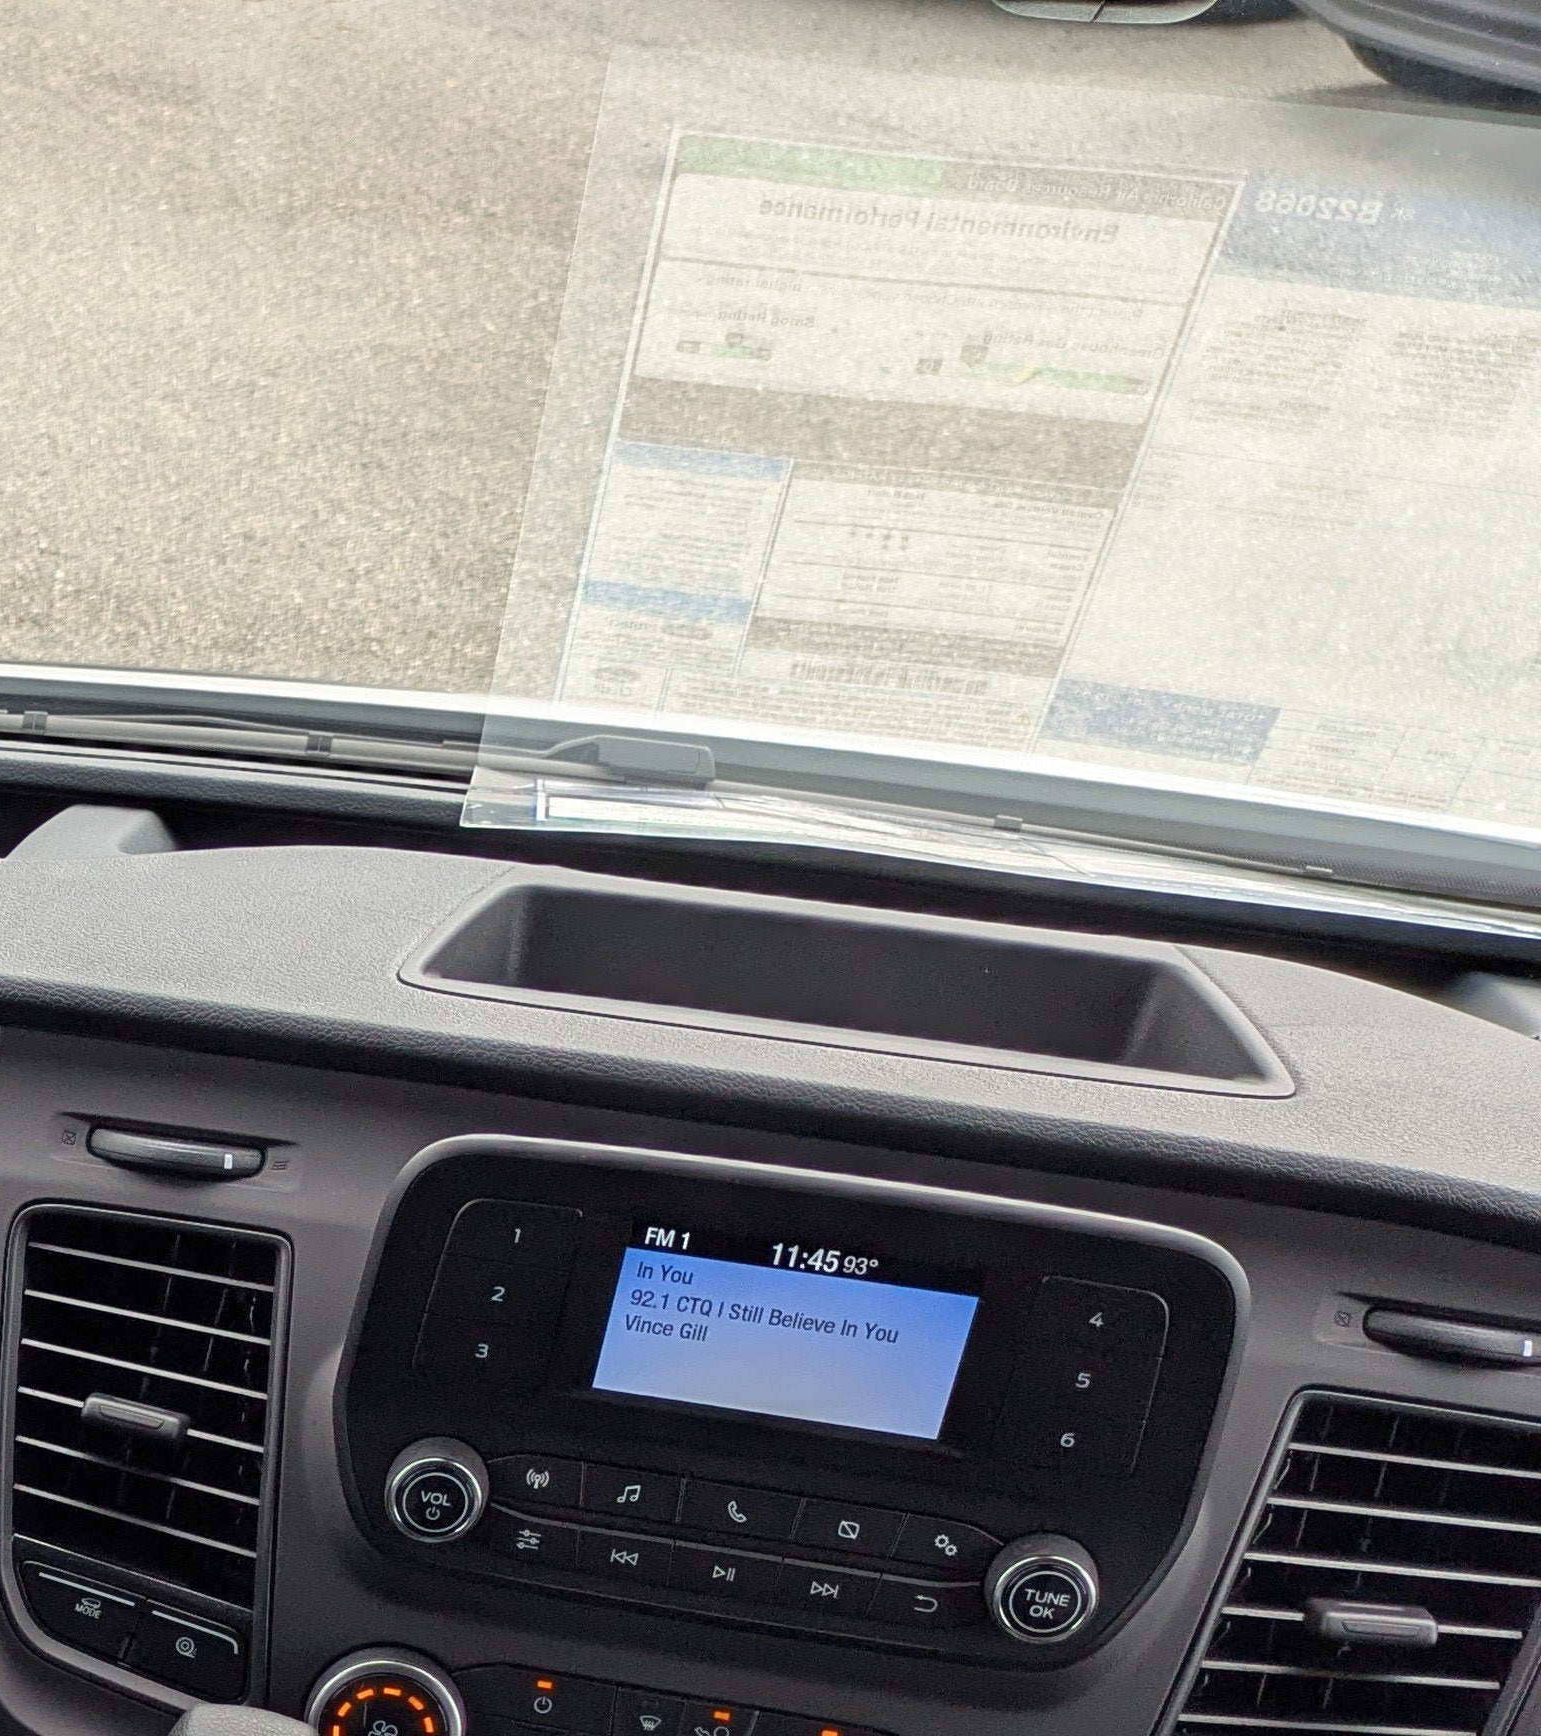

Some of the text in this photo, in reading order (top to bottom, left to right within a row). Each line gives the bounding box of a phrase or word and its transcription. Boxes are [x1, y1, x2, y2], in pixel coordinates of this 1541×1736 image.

[514, 1229, 520, 1244] 1
[644, 1227, 690, 1249] FM 1
[772, 1242, 840, 1273] 11:45
[637, 1263, 694, 1286] In You
[492, 1285, 505, 1302] 2
[630, 1290, 670, 1310] 92.1
[676, 1296, 713, 1318] CTQ
[729, 1303, 763, 1324] Still
[769, 1310, 834, 1333] Believe
[840, 1320, 857, 1338] In
[865, 1322, 900, 1344] You
[1089, 1312, 1104, 1328] 4
[625, 1315, 709, 1342] Vince Gill
[475, 1343, 489, 1359] 3
[1076, 1372, 1090, 1389] 5
[1060, 1432, 1075, 1448] 6
[420, 1491, 451, 1508] VOL
[1024, 1588, 1070, 1608] TUNE
[75, 1603, 102, 1619] MODE
[1029, 1602, 1056, 1620] OK
